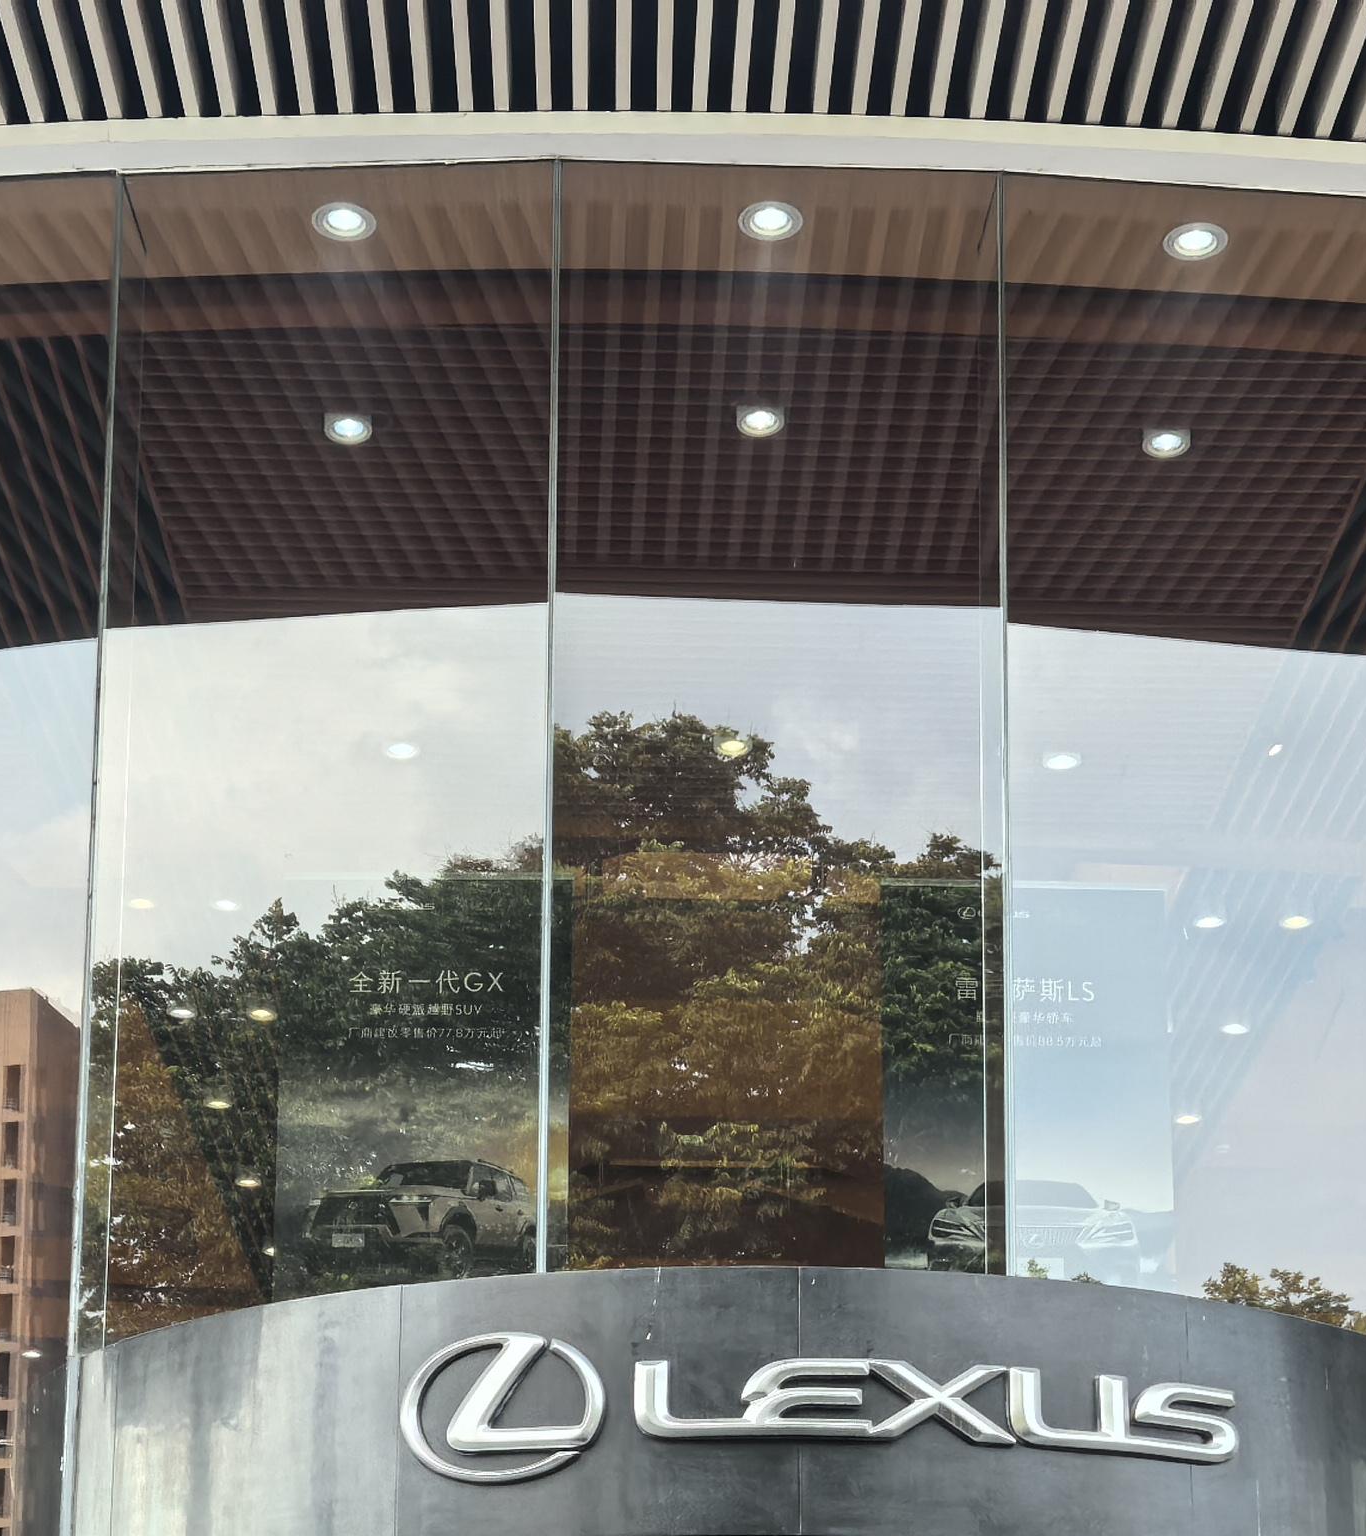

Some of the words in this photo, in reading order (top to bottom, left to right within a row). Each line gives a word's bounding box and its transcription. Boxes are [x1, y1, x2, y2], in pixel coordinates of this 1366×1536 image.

[349, 969, 505, 994] 全新一代GX
[955, 976, 1095, 1003] 雷萨斯LS
[634, 1357, 1238, 1464] LEXUS
